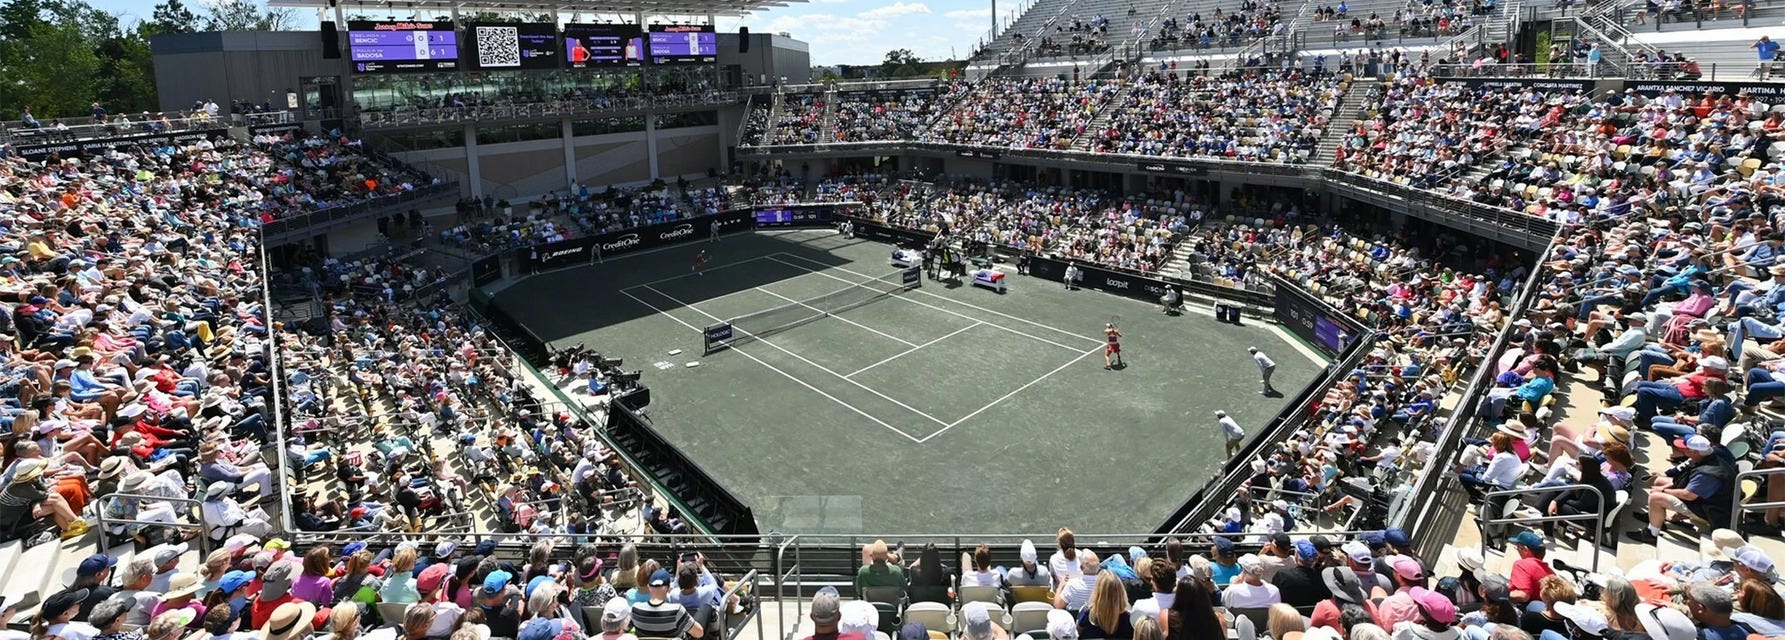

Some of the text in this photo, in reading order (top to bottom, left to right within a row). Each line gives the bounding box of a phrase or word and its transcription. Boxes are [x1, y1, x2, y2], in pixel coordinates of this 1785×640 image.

[1740, 86, 1776, 94] MARTINA
[21, 147, 47, 156] SLOANE
[47, 145, 78, 154] STEPHENS
[551, 246, 583, 257] BOEING
[1106, 277, 1129, 289] Loopit
